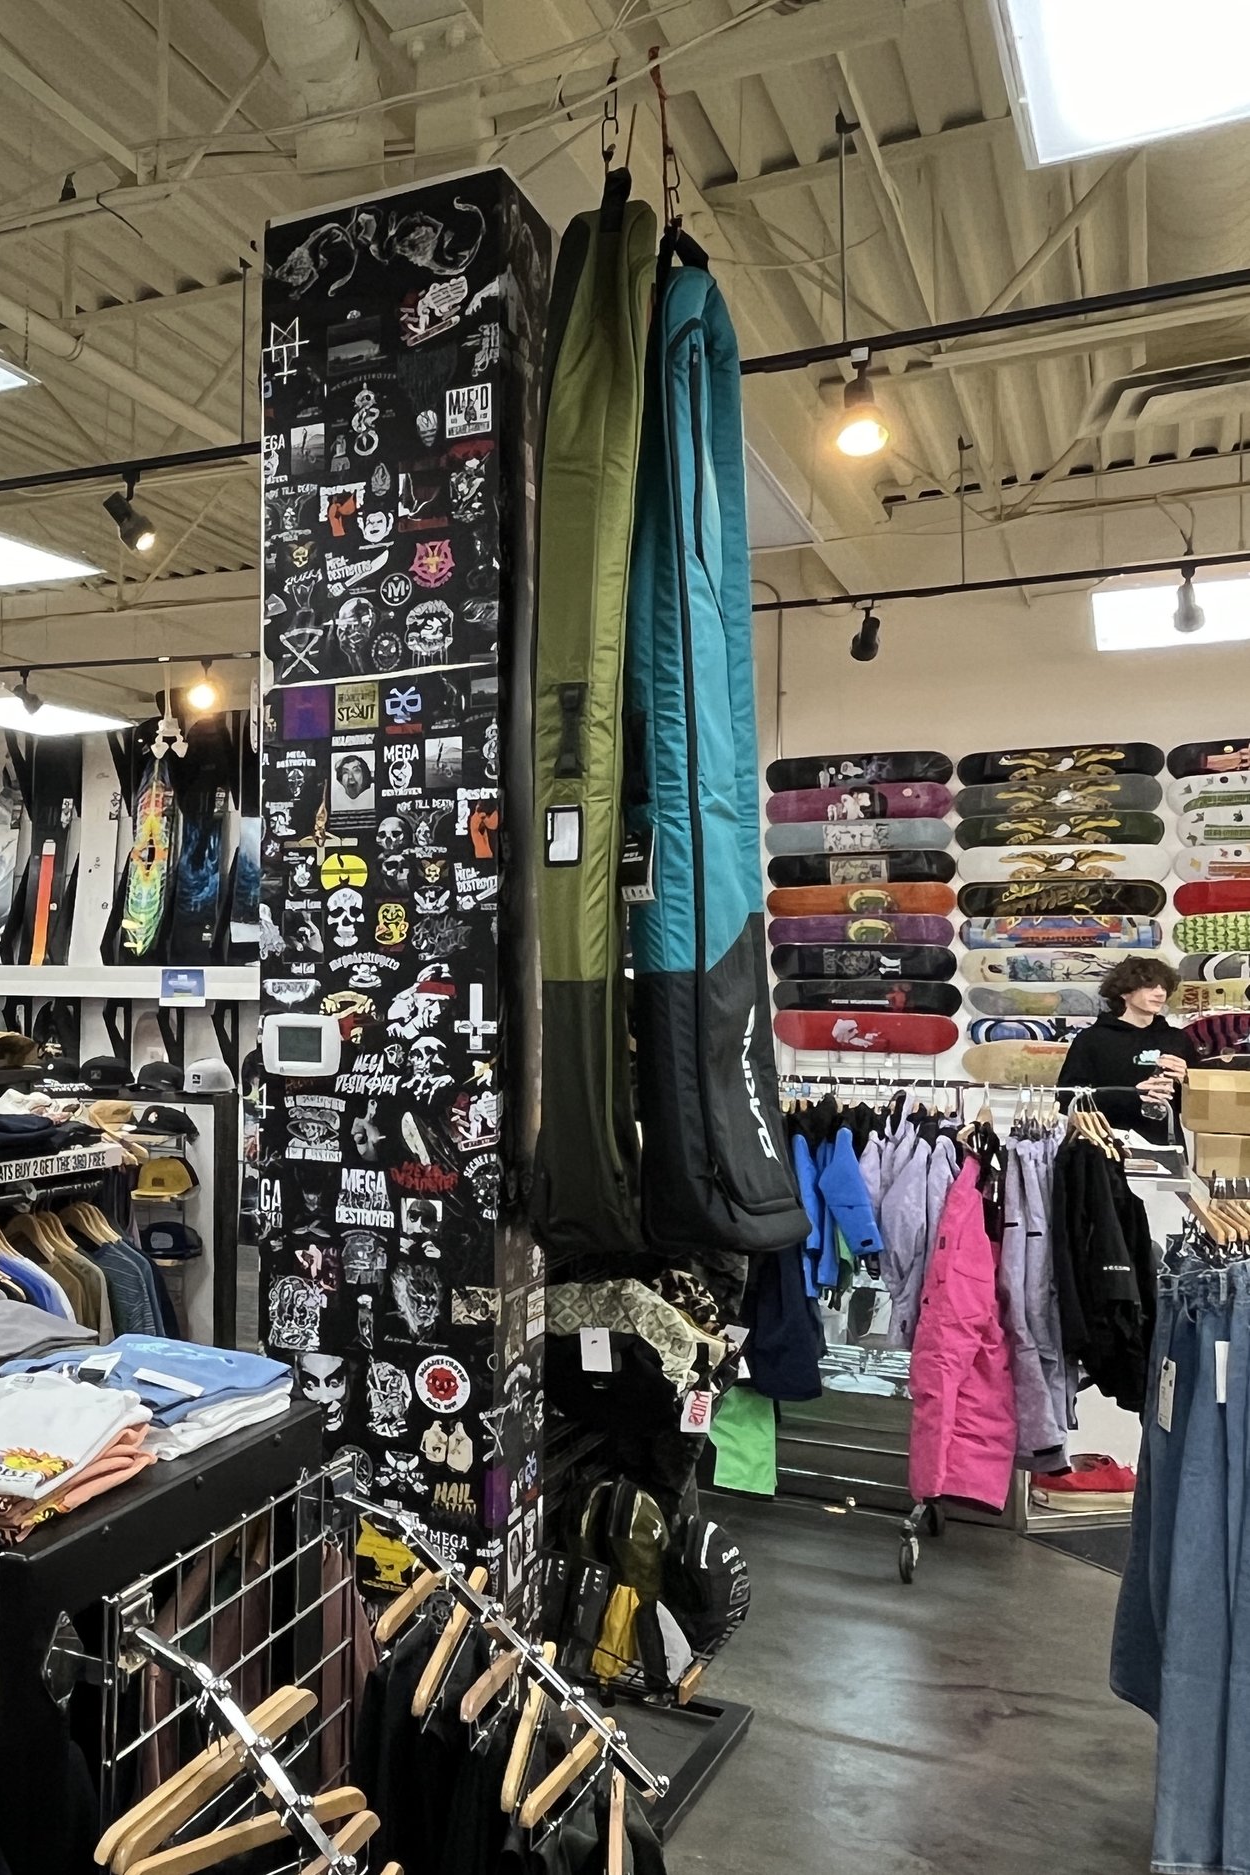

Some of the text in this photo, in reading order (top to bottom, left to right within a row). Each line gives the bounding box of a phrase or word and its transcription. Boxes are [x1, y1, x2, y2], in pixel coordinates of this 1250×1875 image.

[265, 434, 285, 450] EGA
[384, 744, 420, 762] MEGA
[415, 799, 430, 809] TILL
[352, 1053, 385, 1076] MEGA
[334, 1073, 401, 1097] DESTROYER
[15, 1161, 31, 1179] BUY
[32, 1159, 39, 1176] 2
[40, 1157, 55, 1176] GET
[341, 1168, 387, 1195] MEGA
[260, 1178, 282, 1212] GA
[335, 1206, 395, 1228] DESTROYER
[434, 1481, 474, 1504] HAIL
[429, 1530, 469, 1553] MEGA
